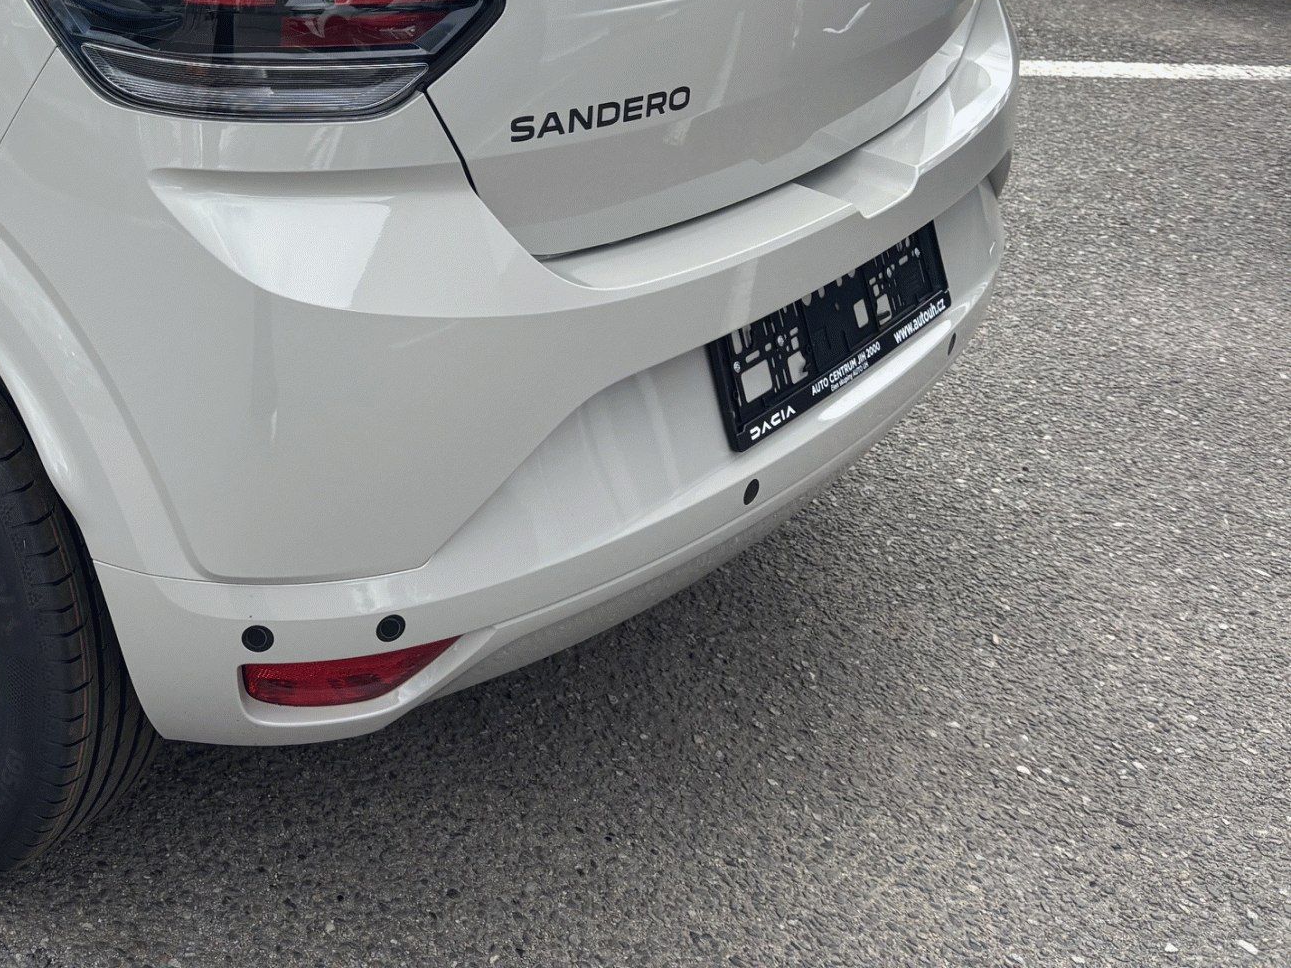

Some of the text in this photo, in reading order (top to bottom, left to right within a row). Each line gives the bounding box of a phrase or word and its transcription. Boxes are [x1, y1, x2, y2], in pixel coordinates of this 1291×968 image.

[510, 86, 690, 142] SANDERO
[893, 298, 946, 344] www.autouh.cz
[811, 377, 828, 396] AUTO
[829, 358, 857, 383] CENTRUM
[866, 341, 881, 358] 2000
[750, 405, 796, 440] DACIA
